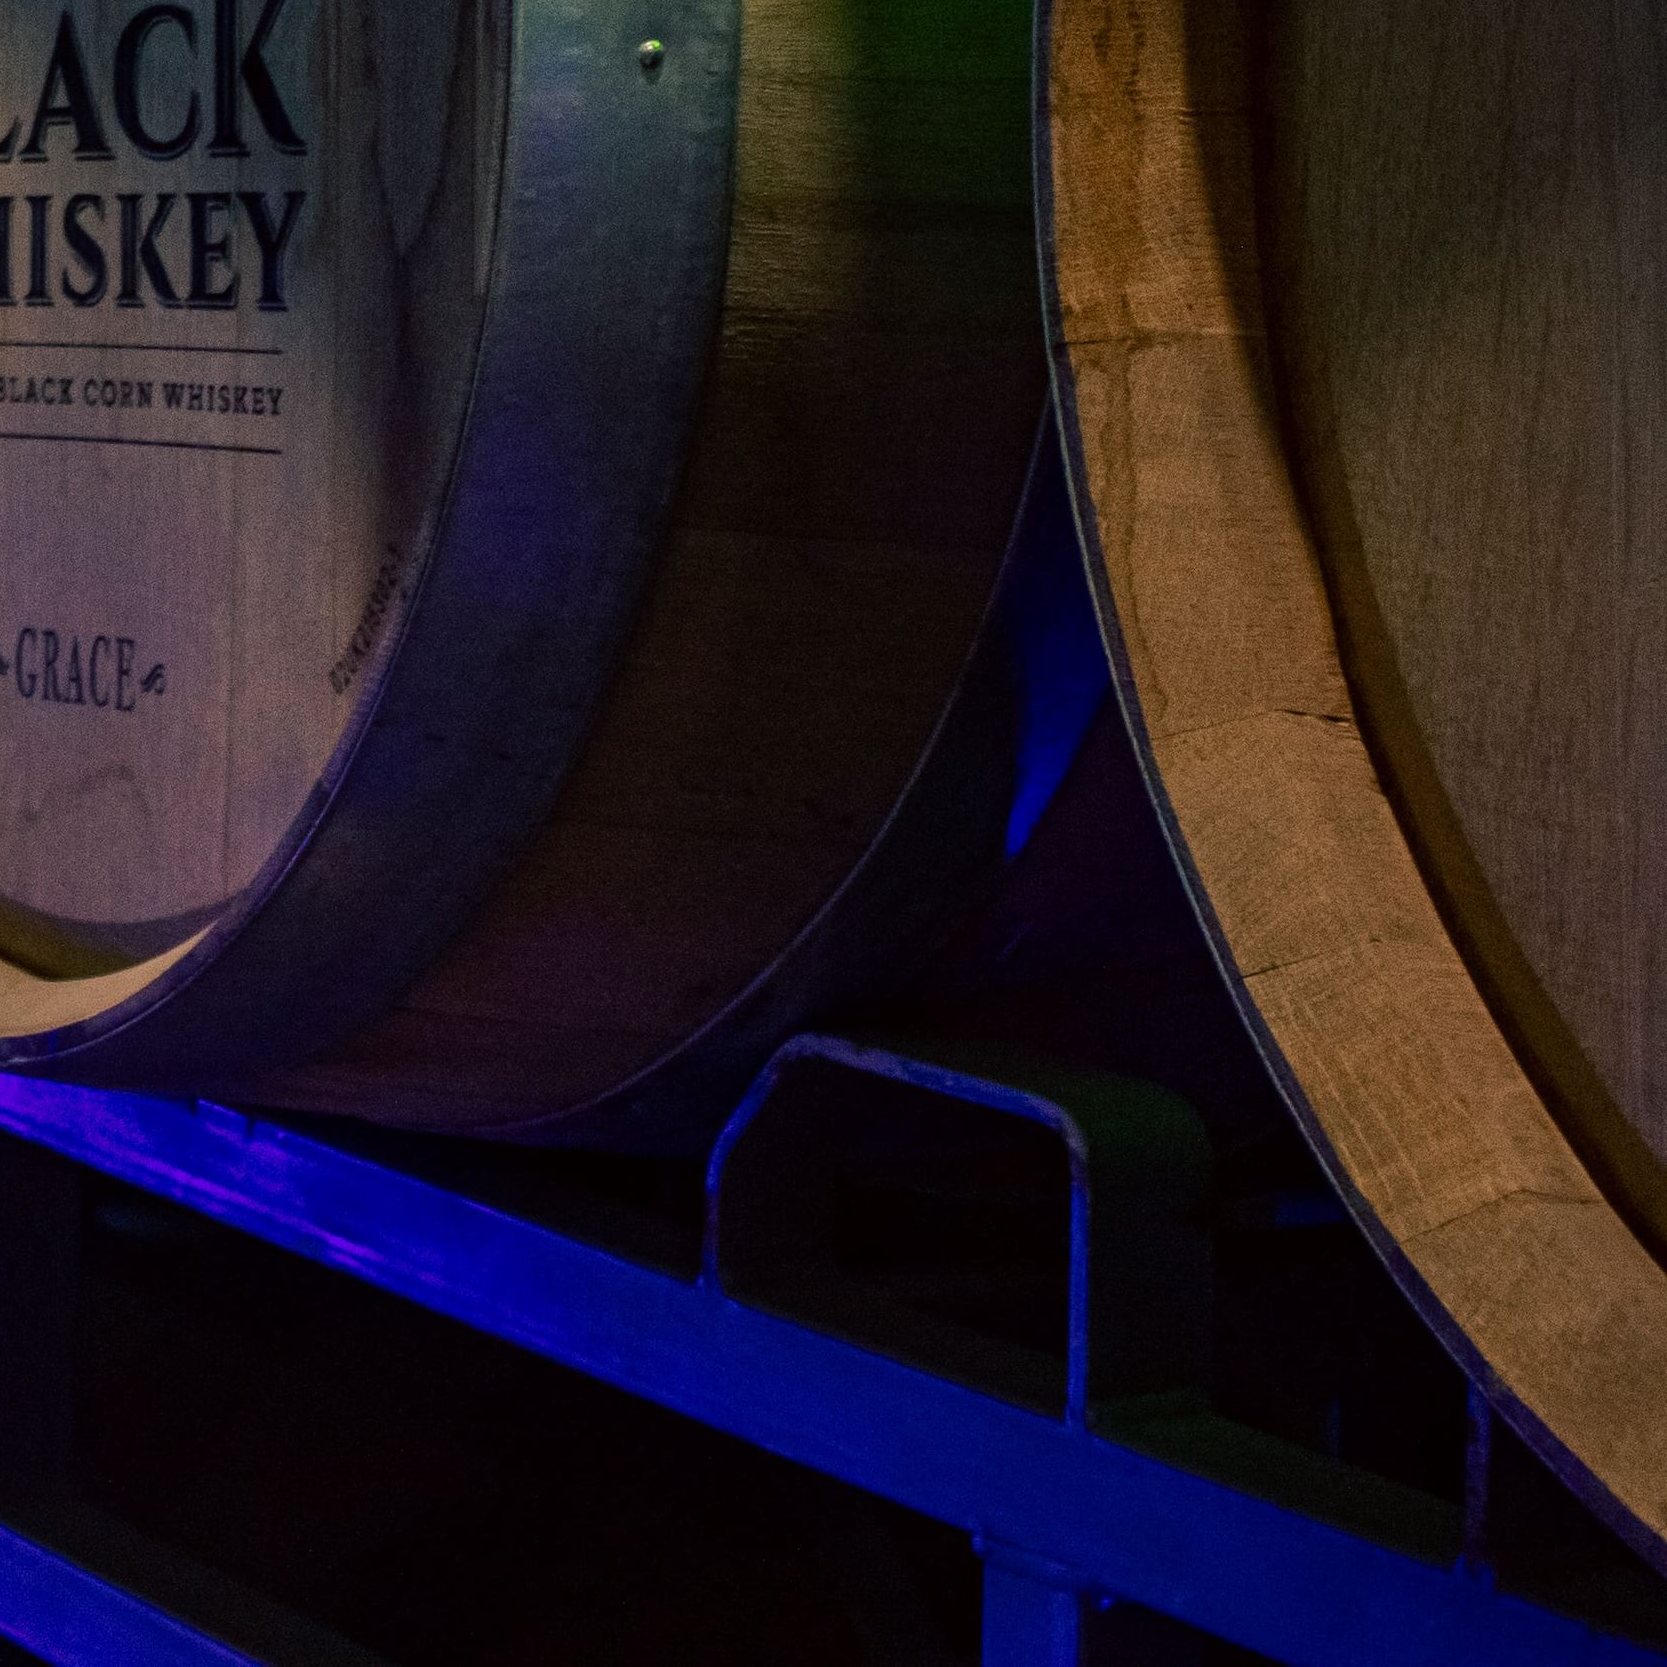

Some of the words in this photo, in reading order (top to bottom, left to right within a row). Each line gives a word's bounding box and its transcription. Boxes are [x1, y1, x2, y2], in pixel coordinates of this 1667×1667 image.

[83, 381, 154, 410] CORN
[163, 381, 284, 417] WHISKEY
[14, 627, 137, 712] GRACE
